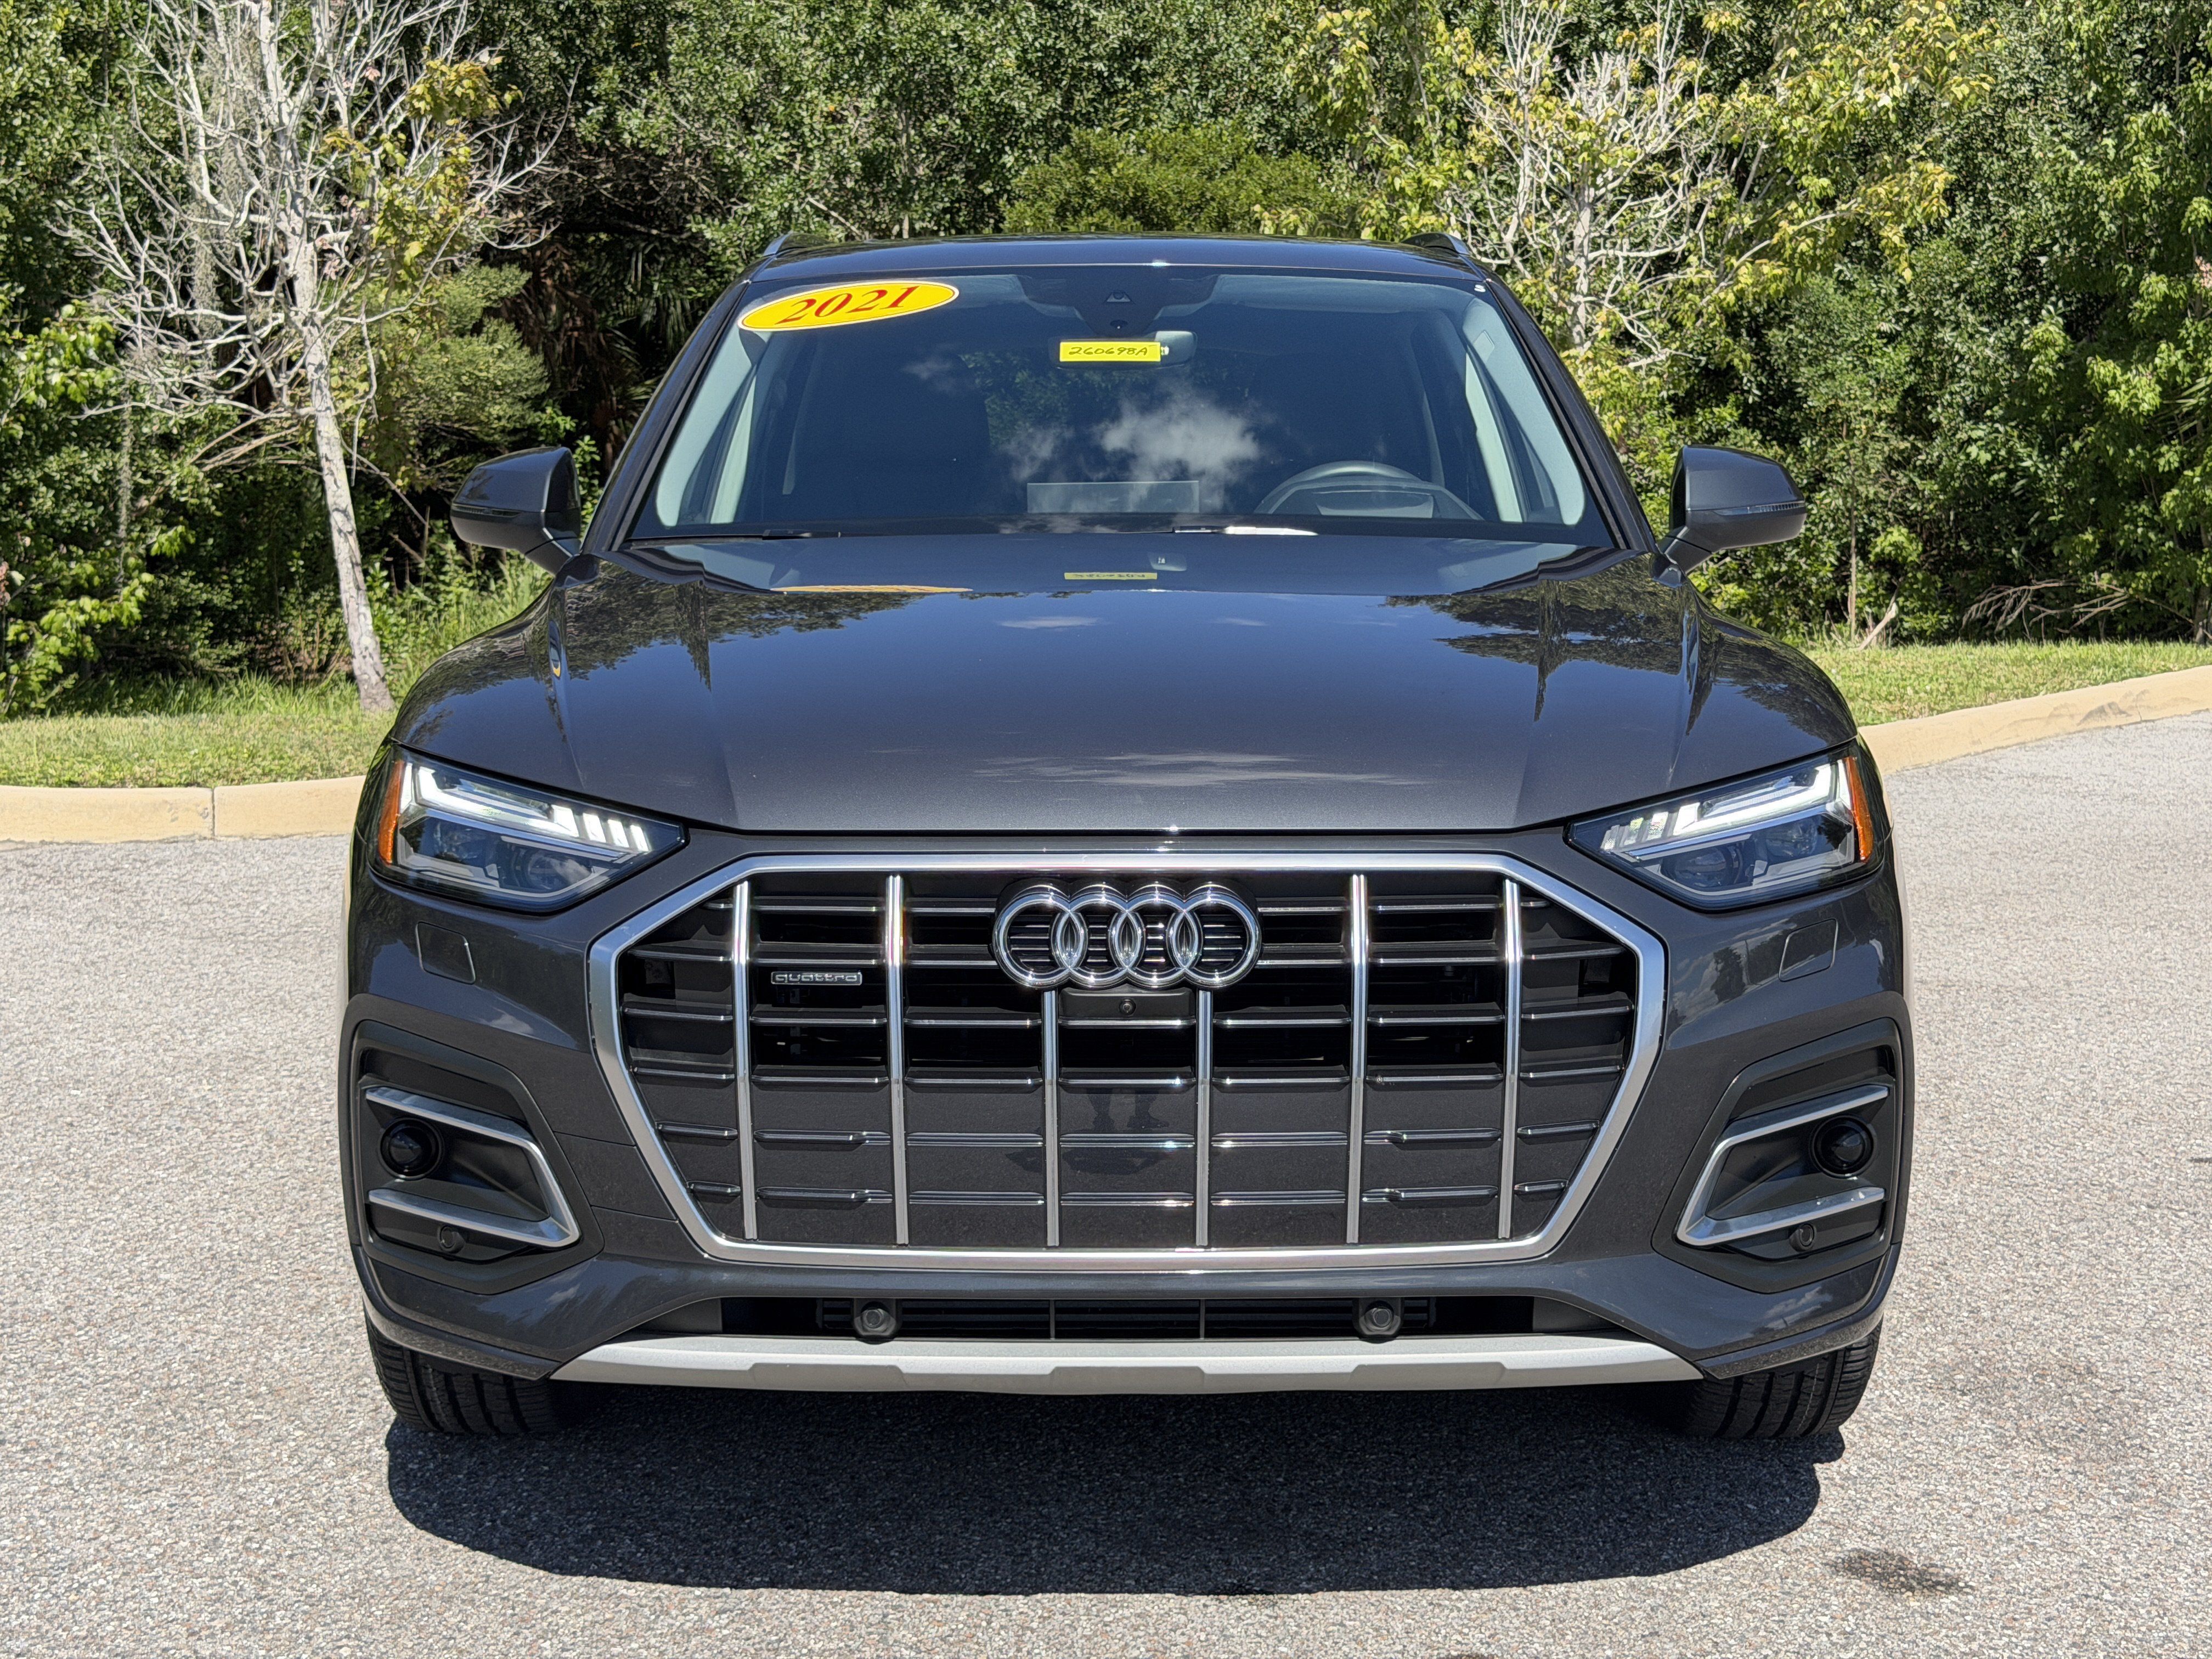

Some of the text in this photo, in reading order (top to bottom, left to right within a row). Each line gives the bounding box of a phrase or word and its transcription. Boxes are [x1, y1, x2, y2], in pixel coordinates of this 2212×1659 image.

[774, 285, 921, 325] 2021
[1068, 347, 1148, 356] 260698A
[775, 974, 857, 983] quattro
